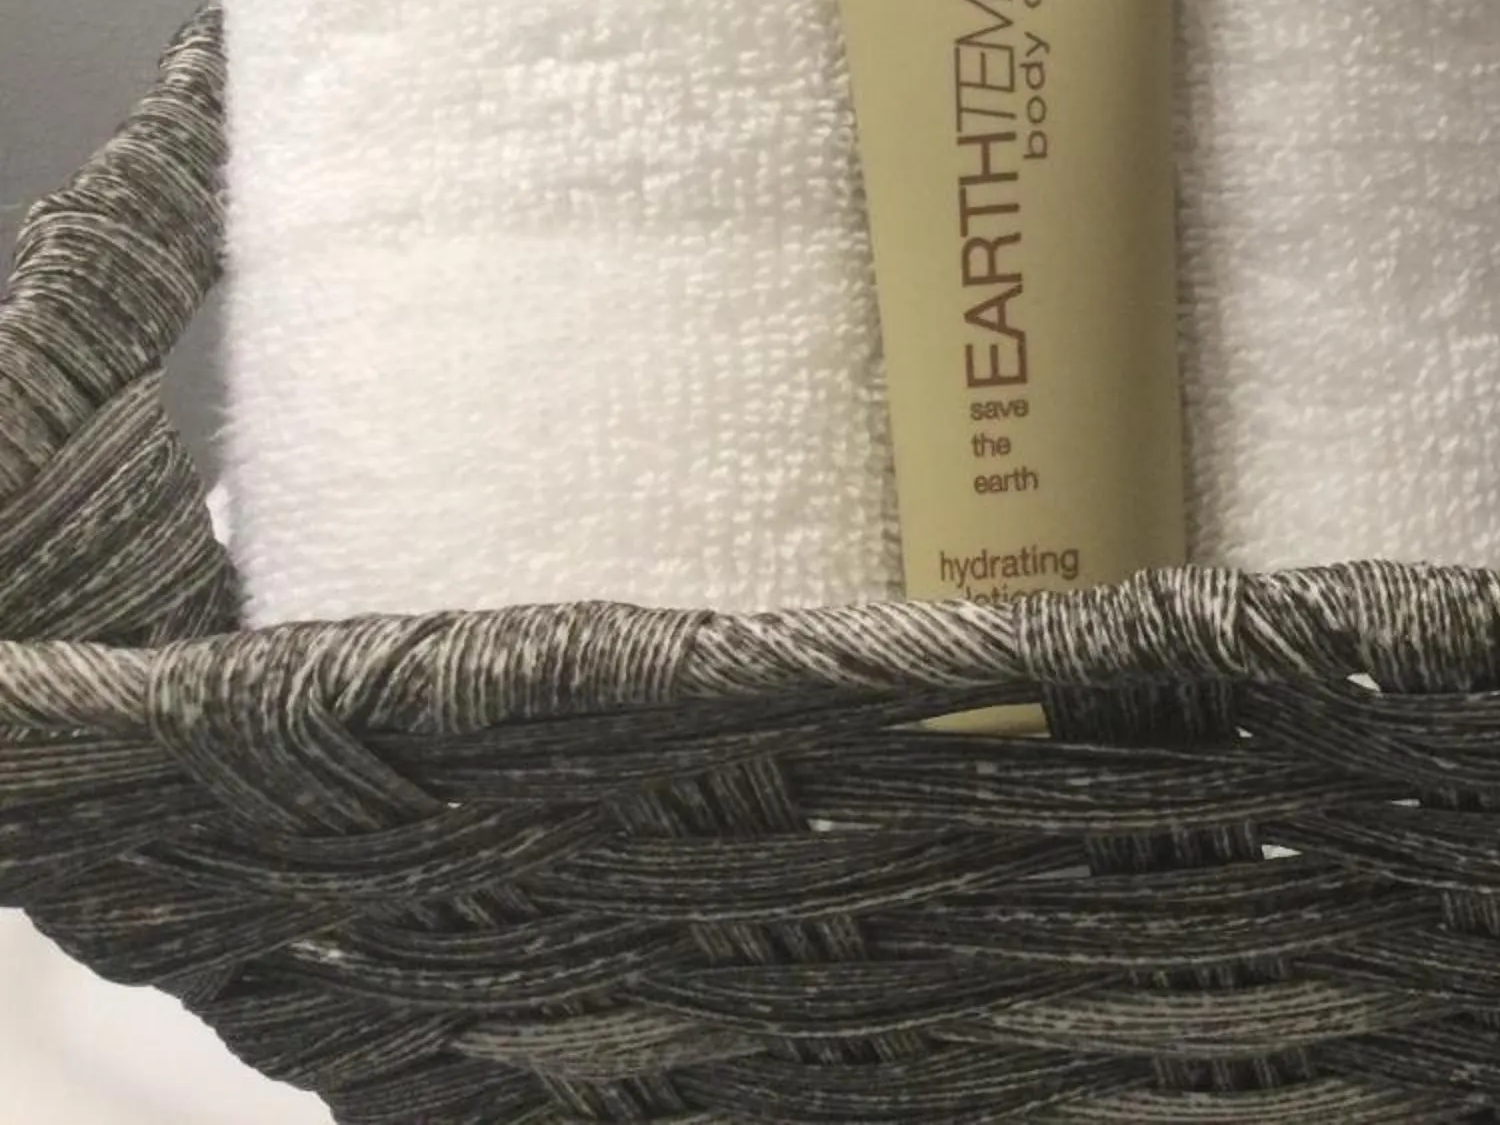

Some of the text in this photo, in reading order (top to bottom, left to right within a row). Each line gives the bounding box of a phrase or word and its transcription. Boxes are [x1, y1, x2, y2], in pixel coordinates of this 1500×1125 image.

[1020, 31, 1050, 160] body
[969, 397, 1029, 421] save
[971, 431, 1012, 458] the
[973, 466, 1039, 494] earth
[939, 545, 1080, 588] hydrating
